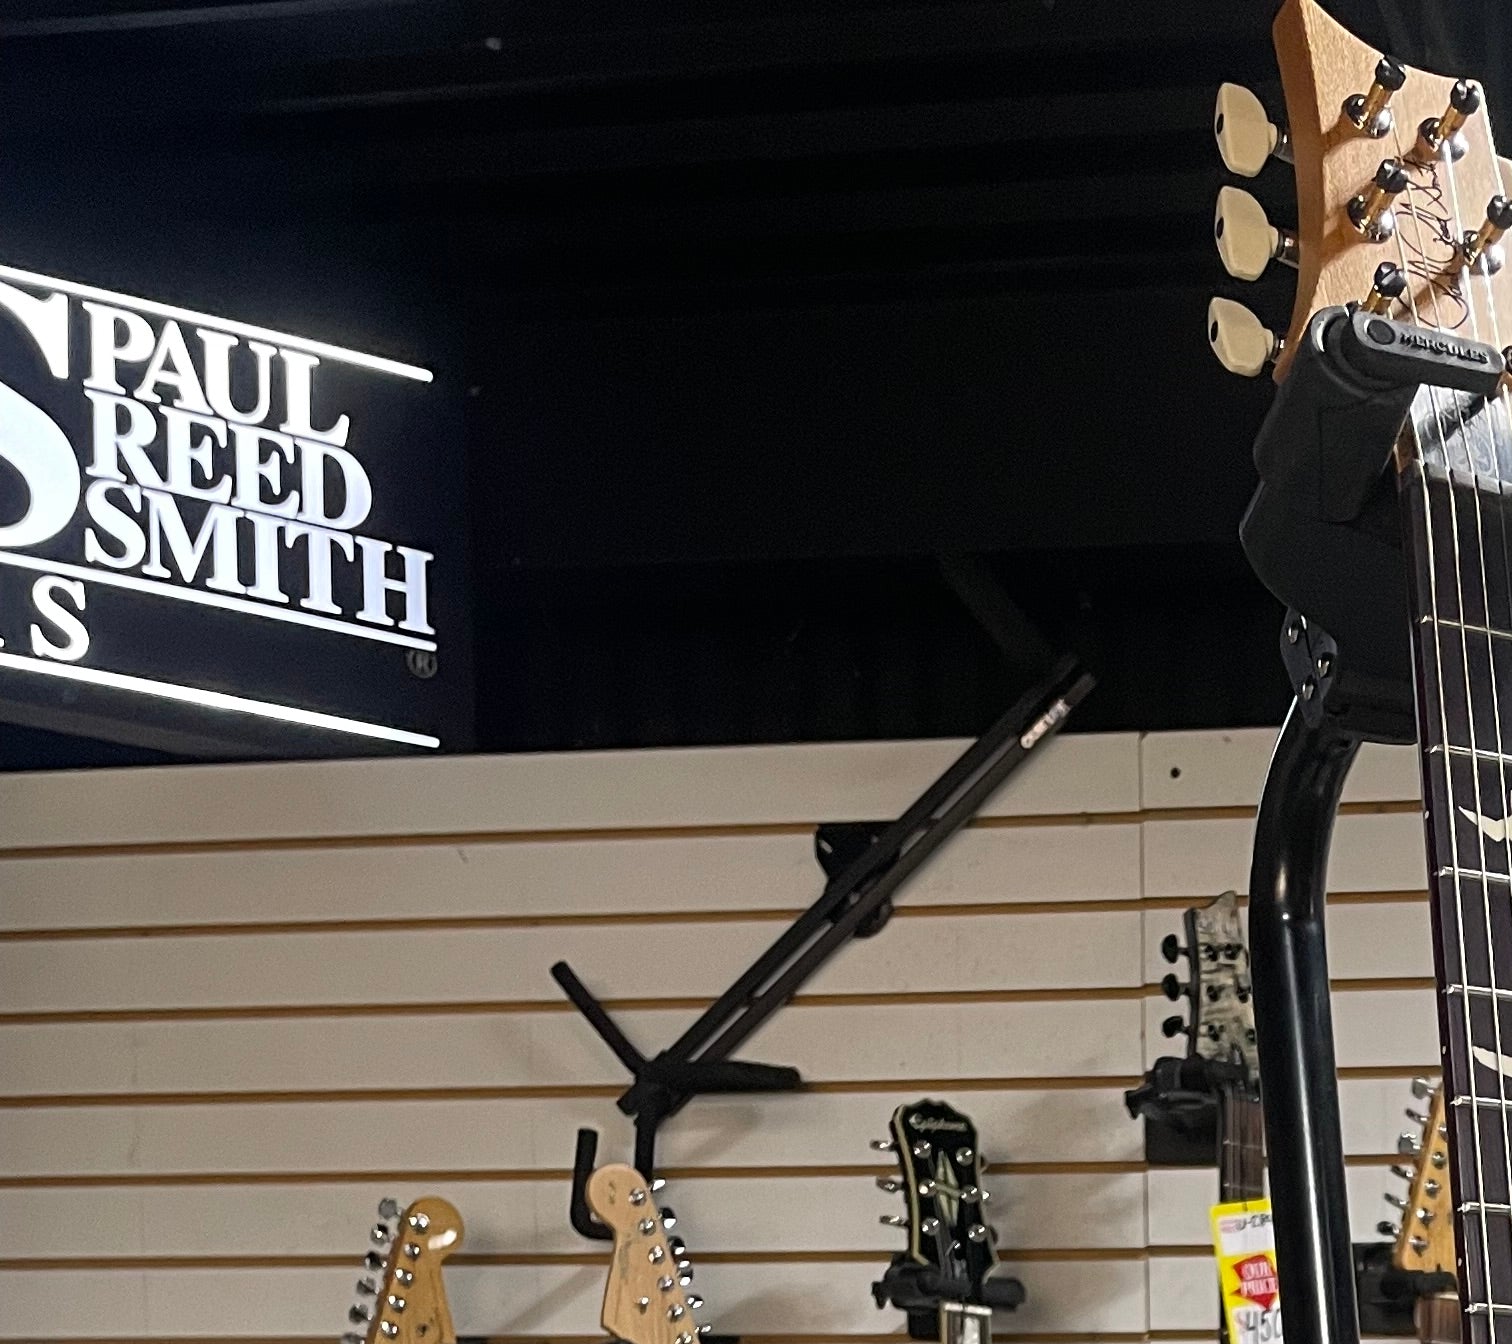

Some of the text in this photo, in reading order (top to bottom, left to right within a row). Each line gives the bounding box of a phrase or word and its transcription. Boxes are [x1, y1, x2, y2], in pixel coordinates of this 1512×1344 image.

[83, 300, 350, 447] PAUL
[1398, 332, 1489, 364] HERCULES
[84, 388, 372, 531] REED
[84, 479, 436, 635] SMITH
